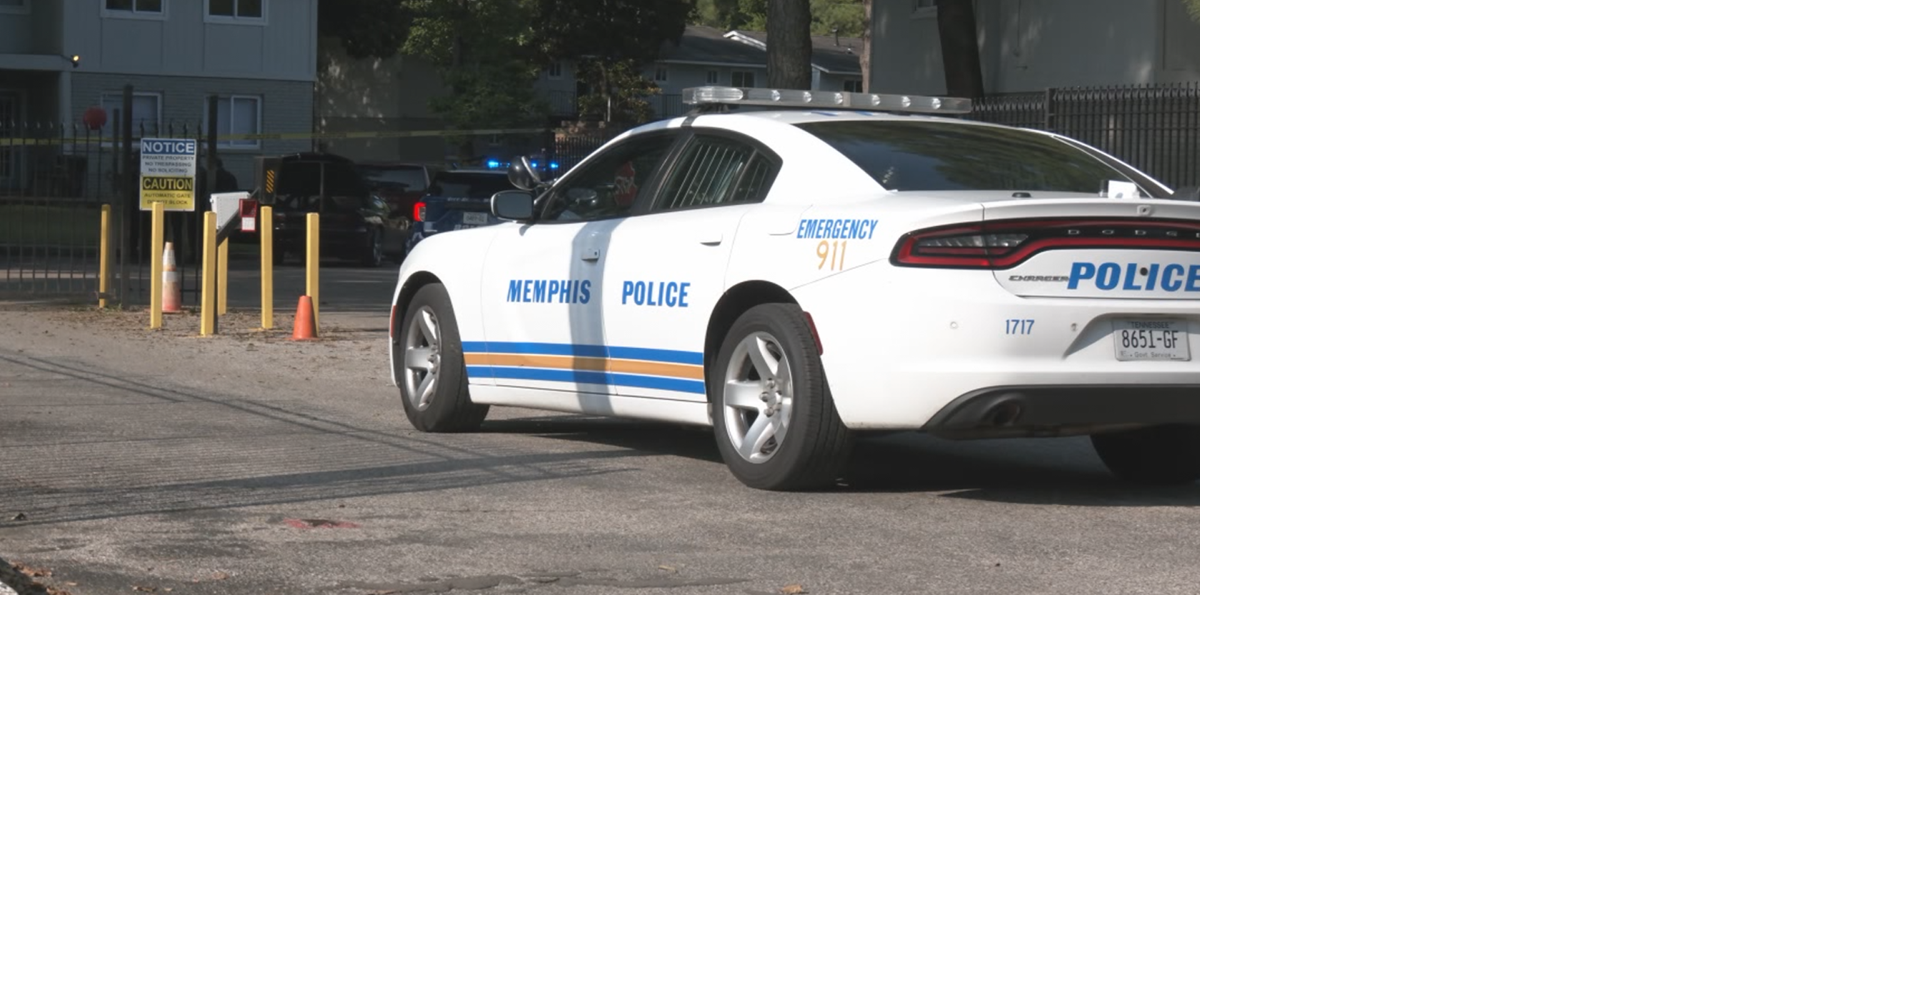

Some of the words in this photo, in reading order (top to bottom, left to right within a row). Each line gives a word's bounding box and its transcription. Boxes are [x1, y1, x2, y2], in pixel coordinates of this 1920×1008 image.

[143, 142, 194, 153] NOTICE
[143, 178, 193, 190] CAUTION
[797, 219, 878, 239] EMERGENCY
[817, 240, 847, 271] 911
[507, 279, 591, 304] MEMPHIS
[622, 280, 690, 307] POLICE
[1006, 319, 1035, 335] 1717
[1121, 329, 1179, 349] 8651-GF
